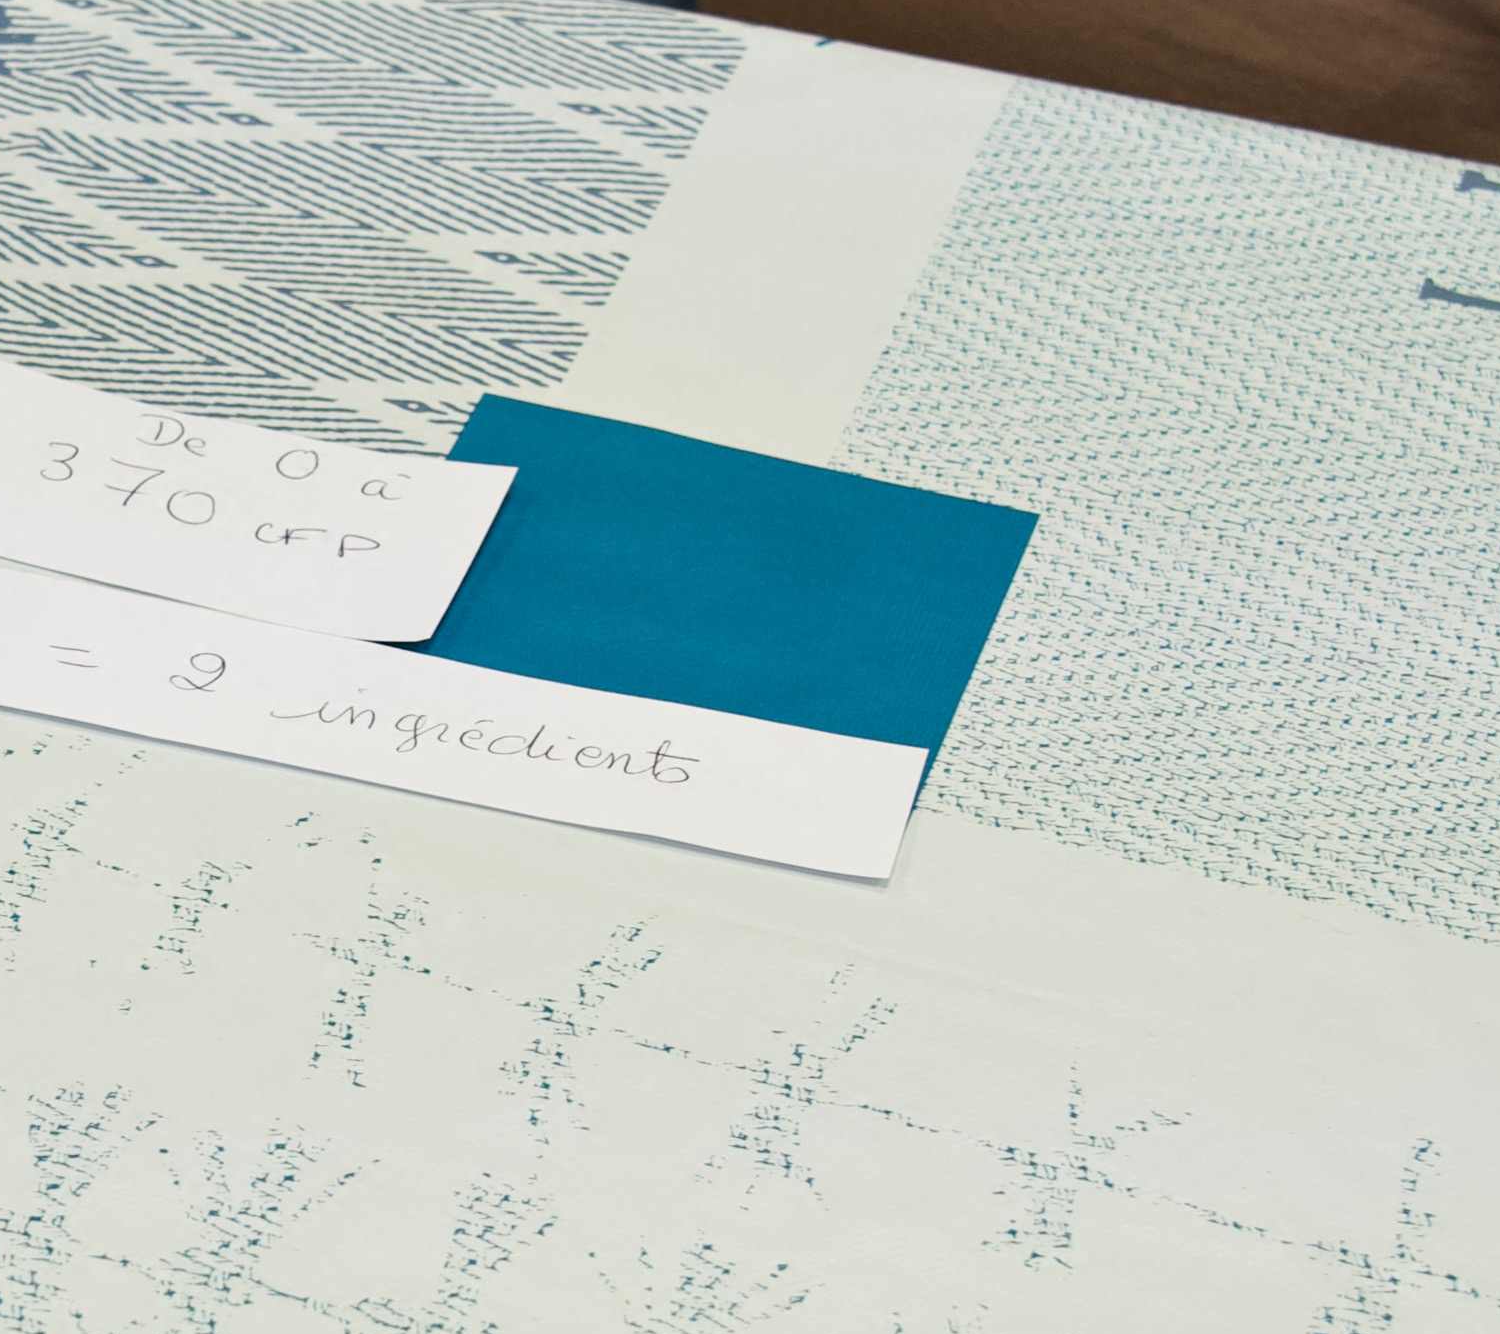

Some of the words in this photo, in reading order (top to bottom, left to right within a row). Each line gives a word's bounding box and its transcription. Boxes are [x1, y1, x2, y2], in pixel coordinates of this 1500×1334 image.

[135, 412, 208, 457] De
[39, 441, 216, 526] 370
[168, 651, 227, 693] 2
